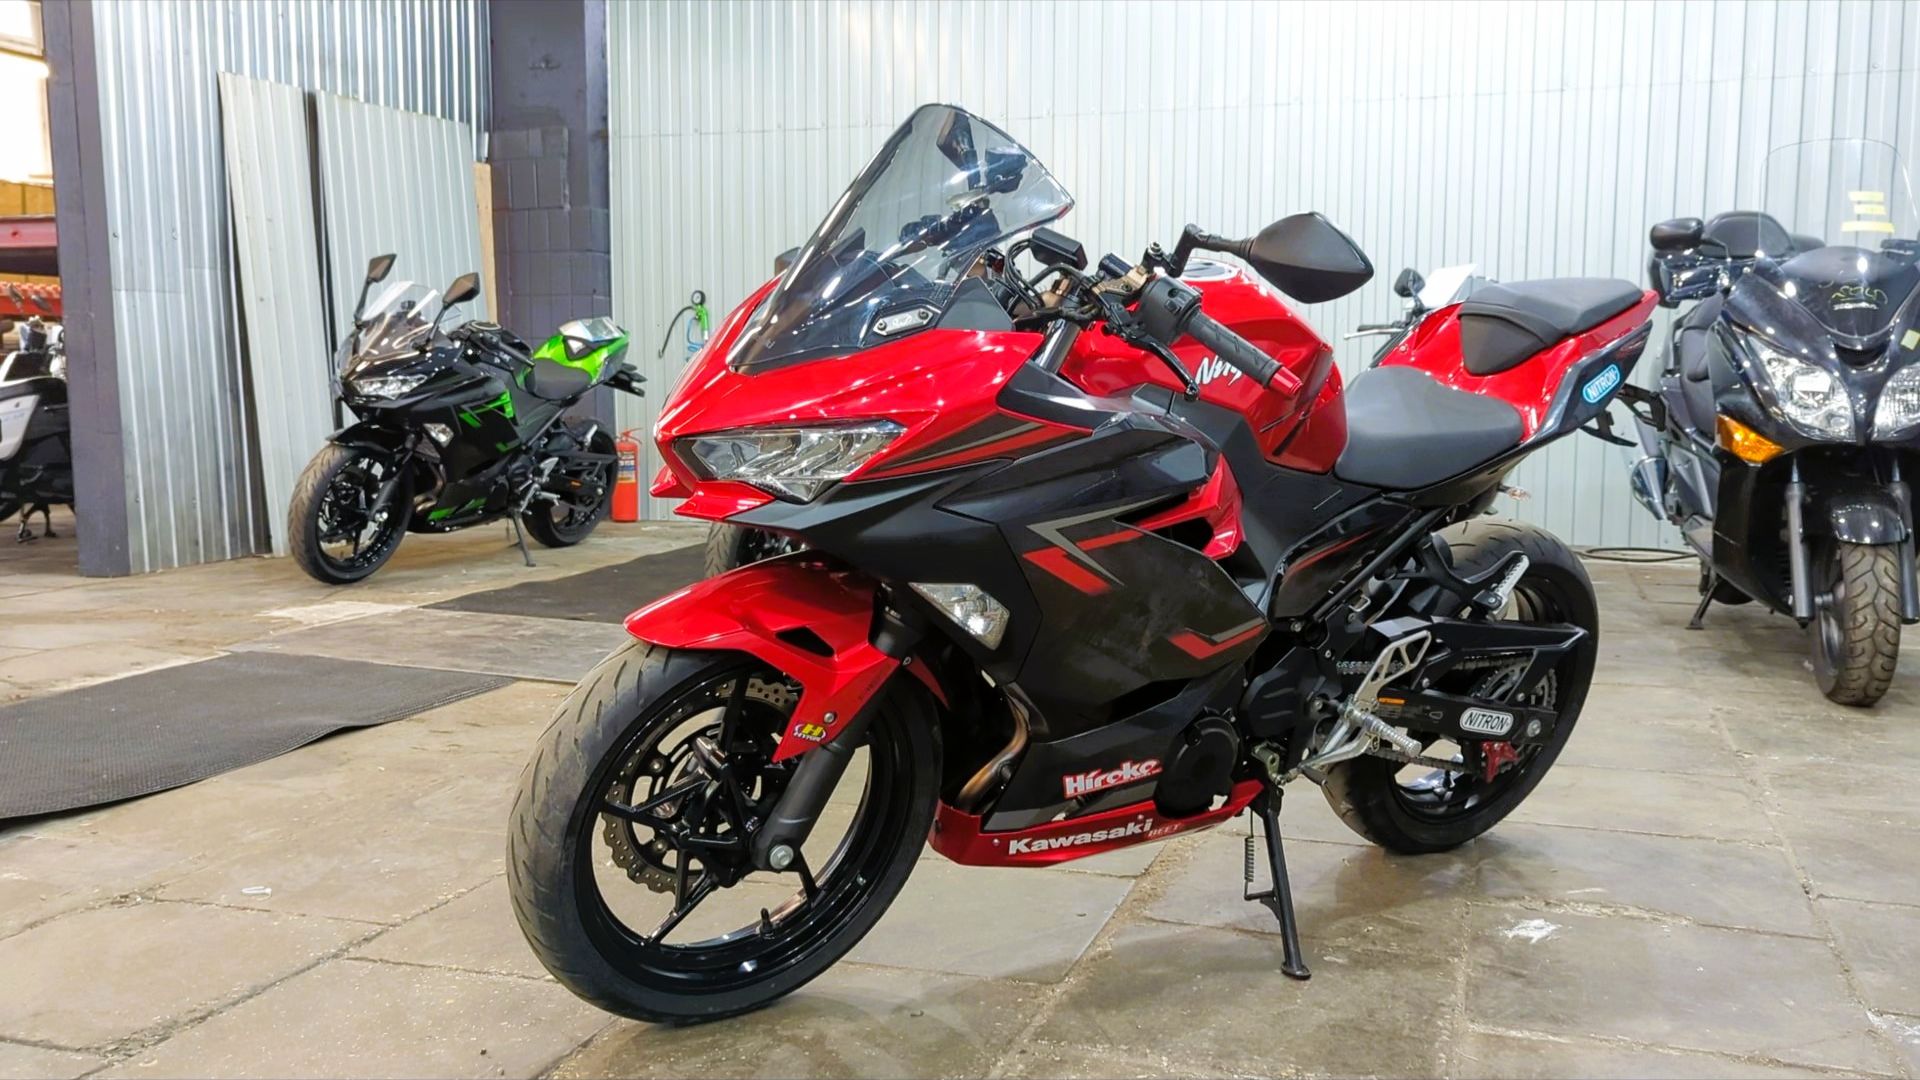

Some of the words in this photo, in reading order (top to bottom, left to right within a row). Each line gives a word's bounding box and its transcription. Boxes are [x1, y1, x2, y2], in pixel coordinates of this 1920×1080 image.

[1585, 366, 1618, 401] NITRON
[1464, 711, 1509, 731] NITRON
[1008, 818, 1153, 855] Kawasaki
